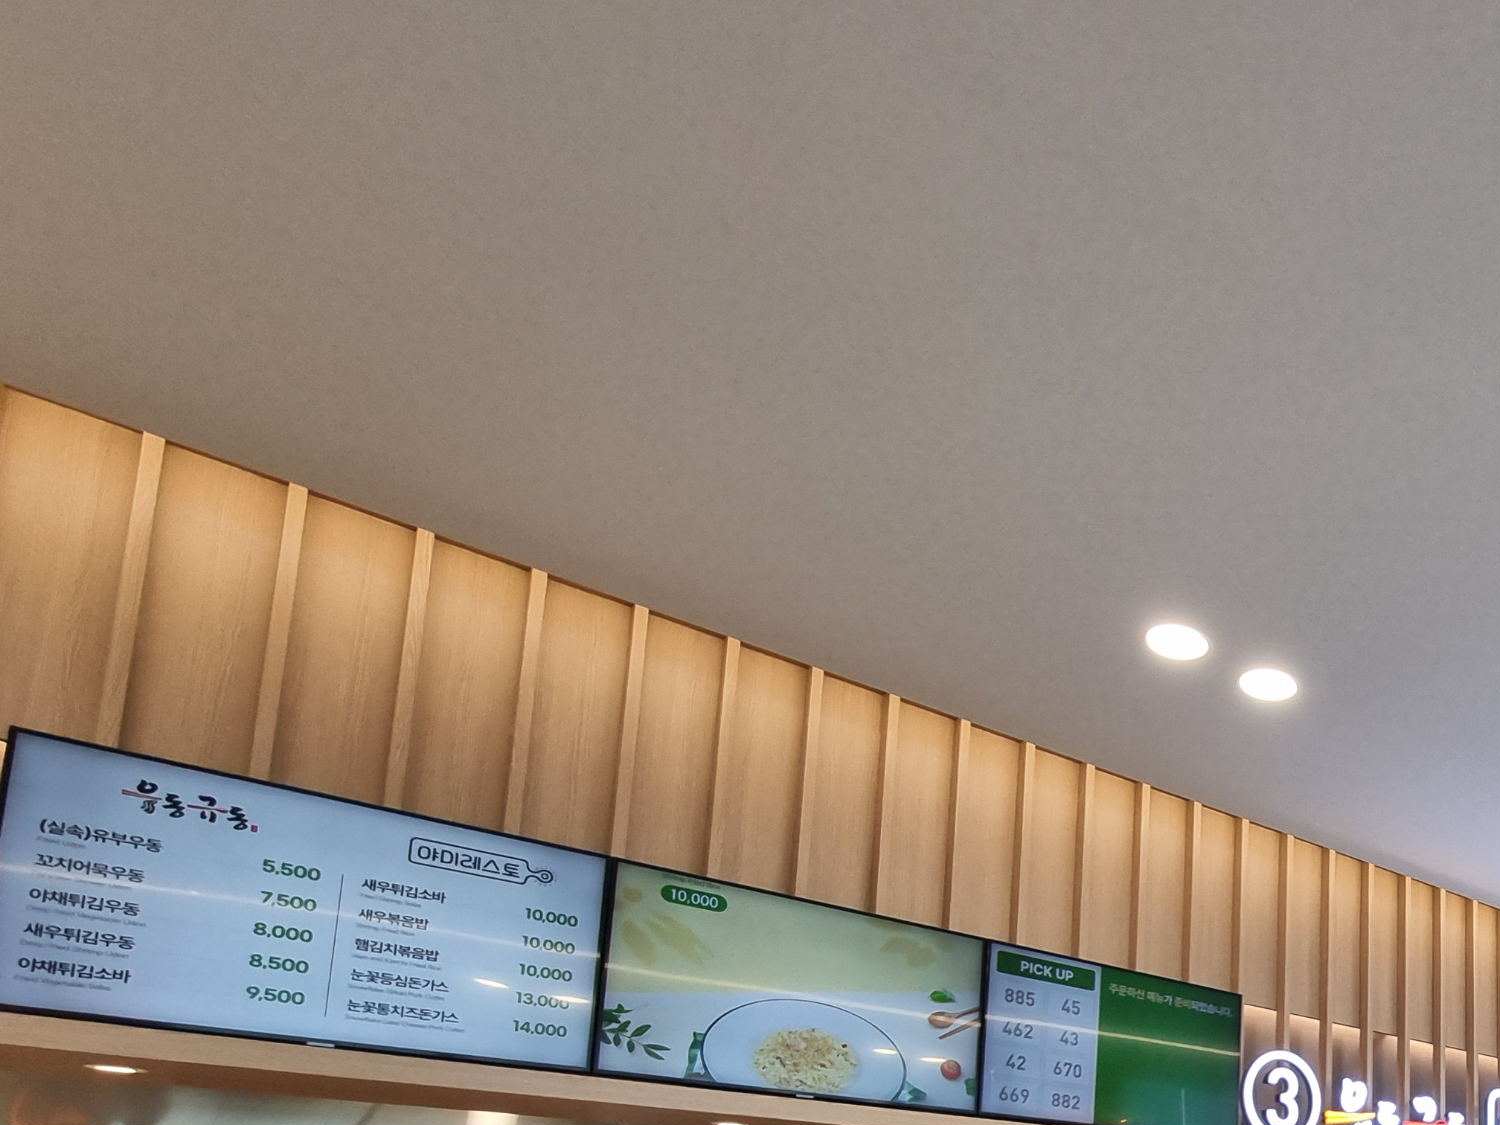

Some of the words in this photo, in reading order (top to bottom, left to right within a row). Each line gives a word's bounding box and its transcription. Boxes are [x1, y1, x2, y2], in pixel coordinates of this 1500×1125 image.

[39, 818, 164, 853] (실속)유부우동
[34, 853, 145, 883] 꼬치어묵우동
[262, 858, 321, 881] 5,500
[417, 845, 521, 879] 야미레스토
[260, 890, 318, 912] 7,500
[361, 878, 447, 904] 새우튀김소바
[671, 888, 719, 909] 10,000
[29, 888, 141, 917] 야채튀김우동
[358, 908, 430, 931] 새우볶음밥
[525, 907, 578, 927] 10,000
[23, 922, 136, 950] 새우튀김우동
[253, 922, 313, 943] 8,000
[355, 938, 440, 962] 햄김치볶음밥
[522, 935, 575, 954] 10,000
[18, 957, 132, 984] 야채튀김소바
[249, 953, 309, 974] 8,500
[519, 963, 573, 982] 10,000
[1020, 960, 1053, 978] PICK
[1055, 969, 1074, 982] UP
[350, 968, 449, 993] 눈꽃등심돈가스
[246, 985, 306, 1005] 9,500
[516, 991, 570, 1010] 13,000
[1004, 988, 1035, 1007] 885
[347, 999, 460, 1024] 눈꽃통치즈돈가스
[1061, 998, 1081, 1016] 45
[513, 1019, 567, 1038] 14,000
[1002, 1020, 1034, 1040] 462
[1059, 1030, 1079, 1047] 43
[1005, 1053, 1027, 1071] 42
[1053, 1060, 1082, 1078] 670
[999, 1085, 1030, 1104] 669
[1051, 1092, 1081, 1111] 882
